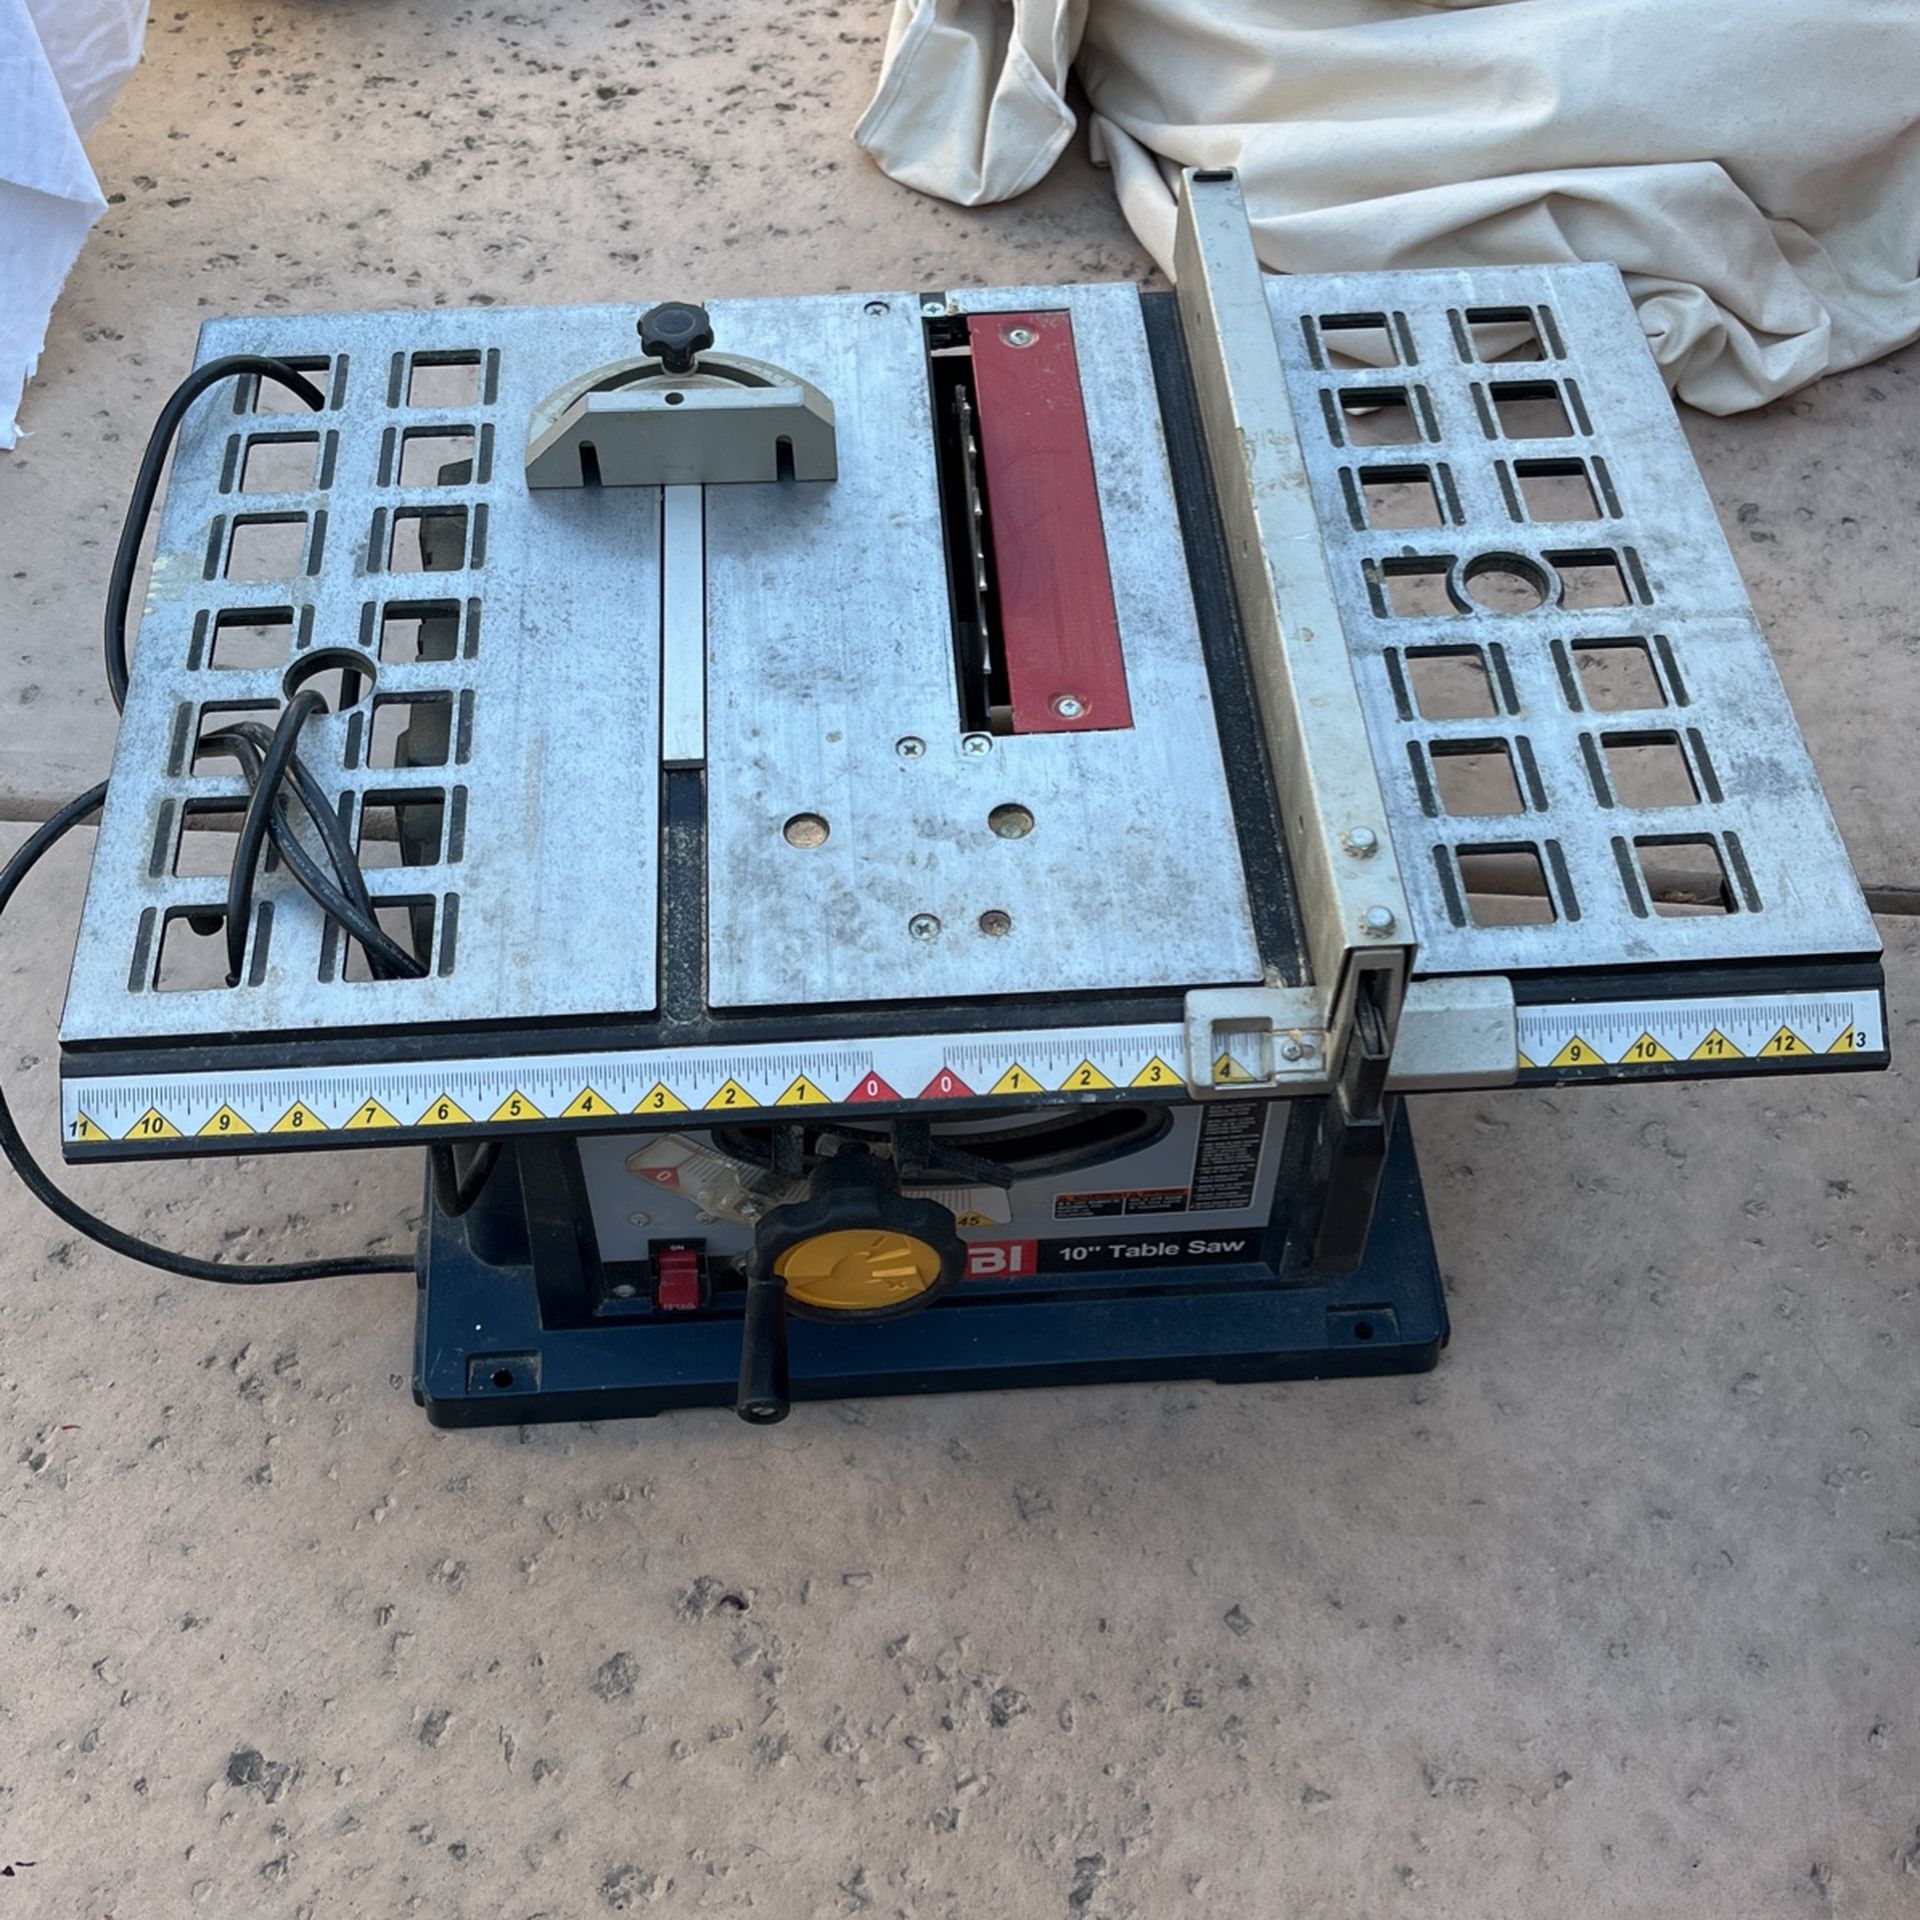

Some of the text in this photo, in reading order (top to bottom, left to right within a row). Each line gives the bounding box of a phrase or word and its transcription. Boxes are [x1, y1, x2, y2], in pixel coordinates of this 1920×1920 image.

[69, 1031, 1867, 1138] 11 10 9 8 7 6 5 4 3 2 1 0 0 1 2 3 4 9 10 11 12 13
[656, 1170, 672, 1182] 0
[958, 1216, 980, 1227] 45
[1059, 1240, 1245, 1262] 10" Table Saw
